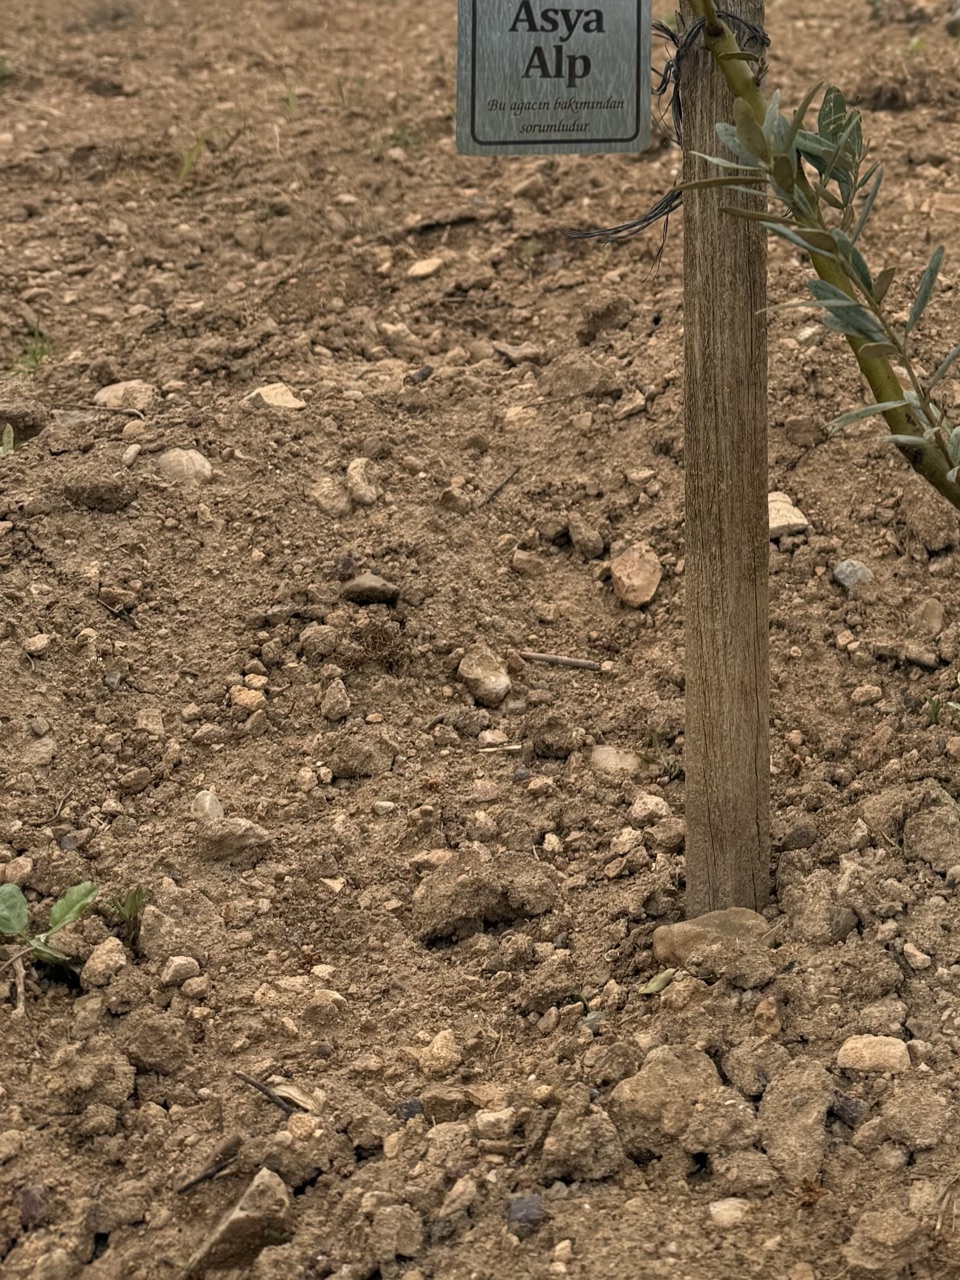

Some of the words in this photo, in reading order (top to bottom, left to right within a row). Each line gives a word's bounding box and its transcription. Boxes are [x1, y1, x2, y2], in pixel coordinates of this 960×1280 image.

[508, 0, 605, 42] Asya
[521, 45, 591, 88] Alp
[487, 99, 506, 111] Bu
[510, 98, 550, 116] ağacın
[553, 95, 624, 113] bakımından
